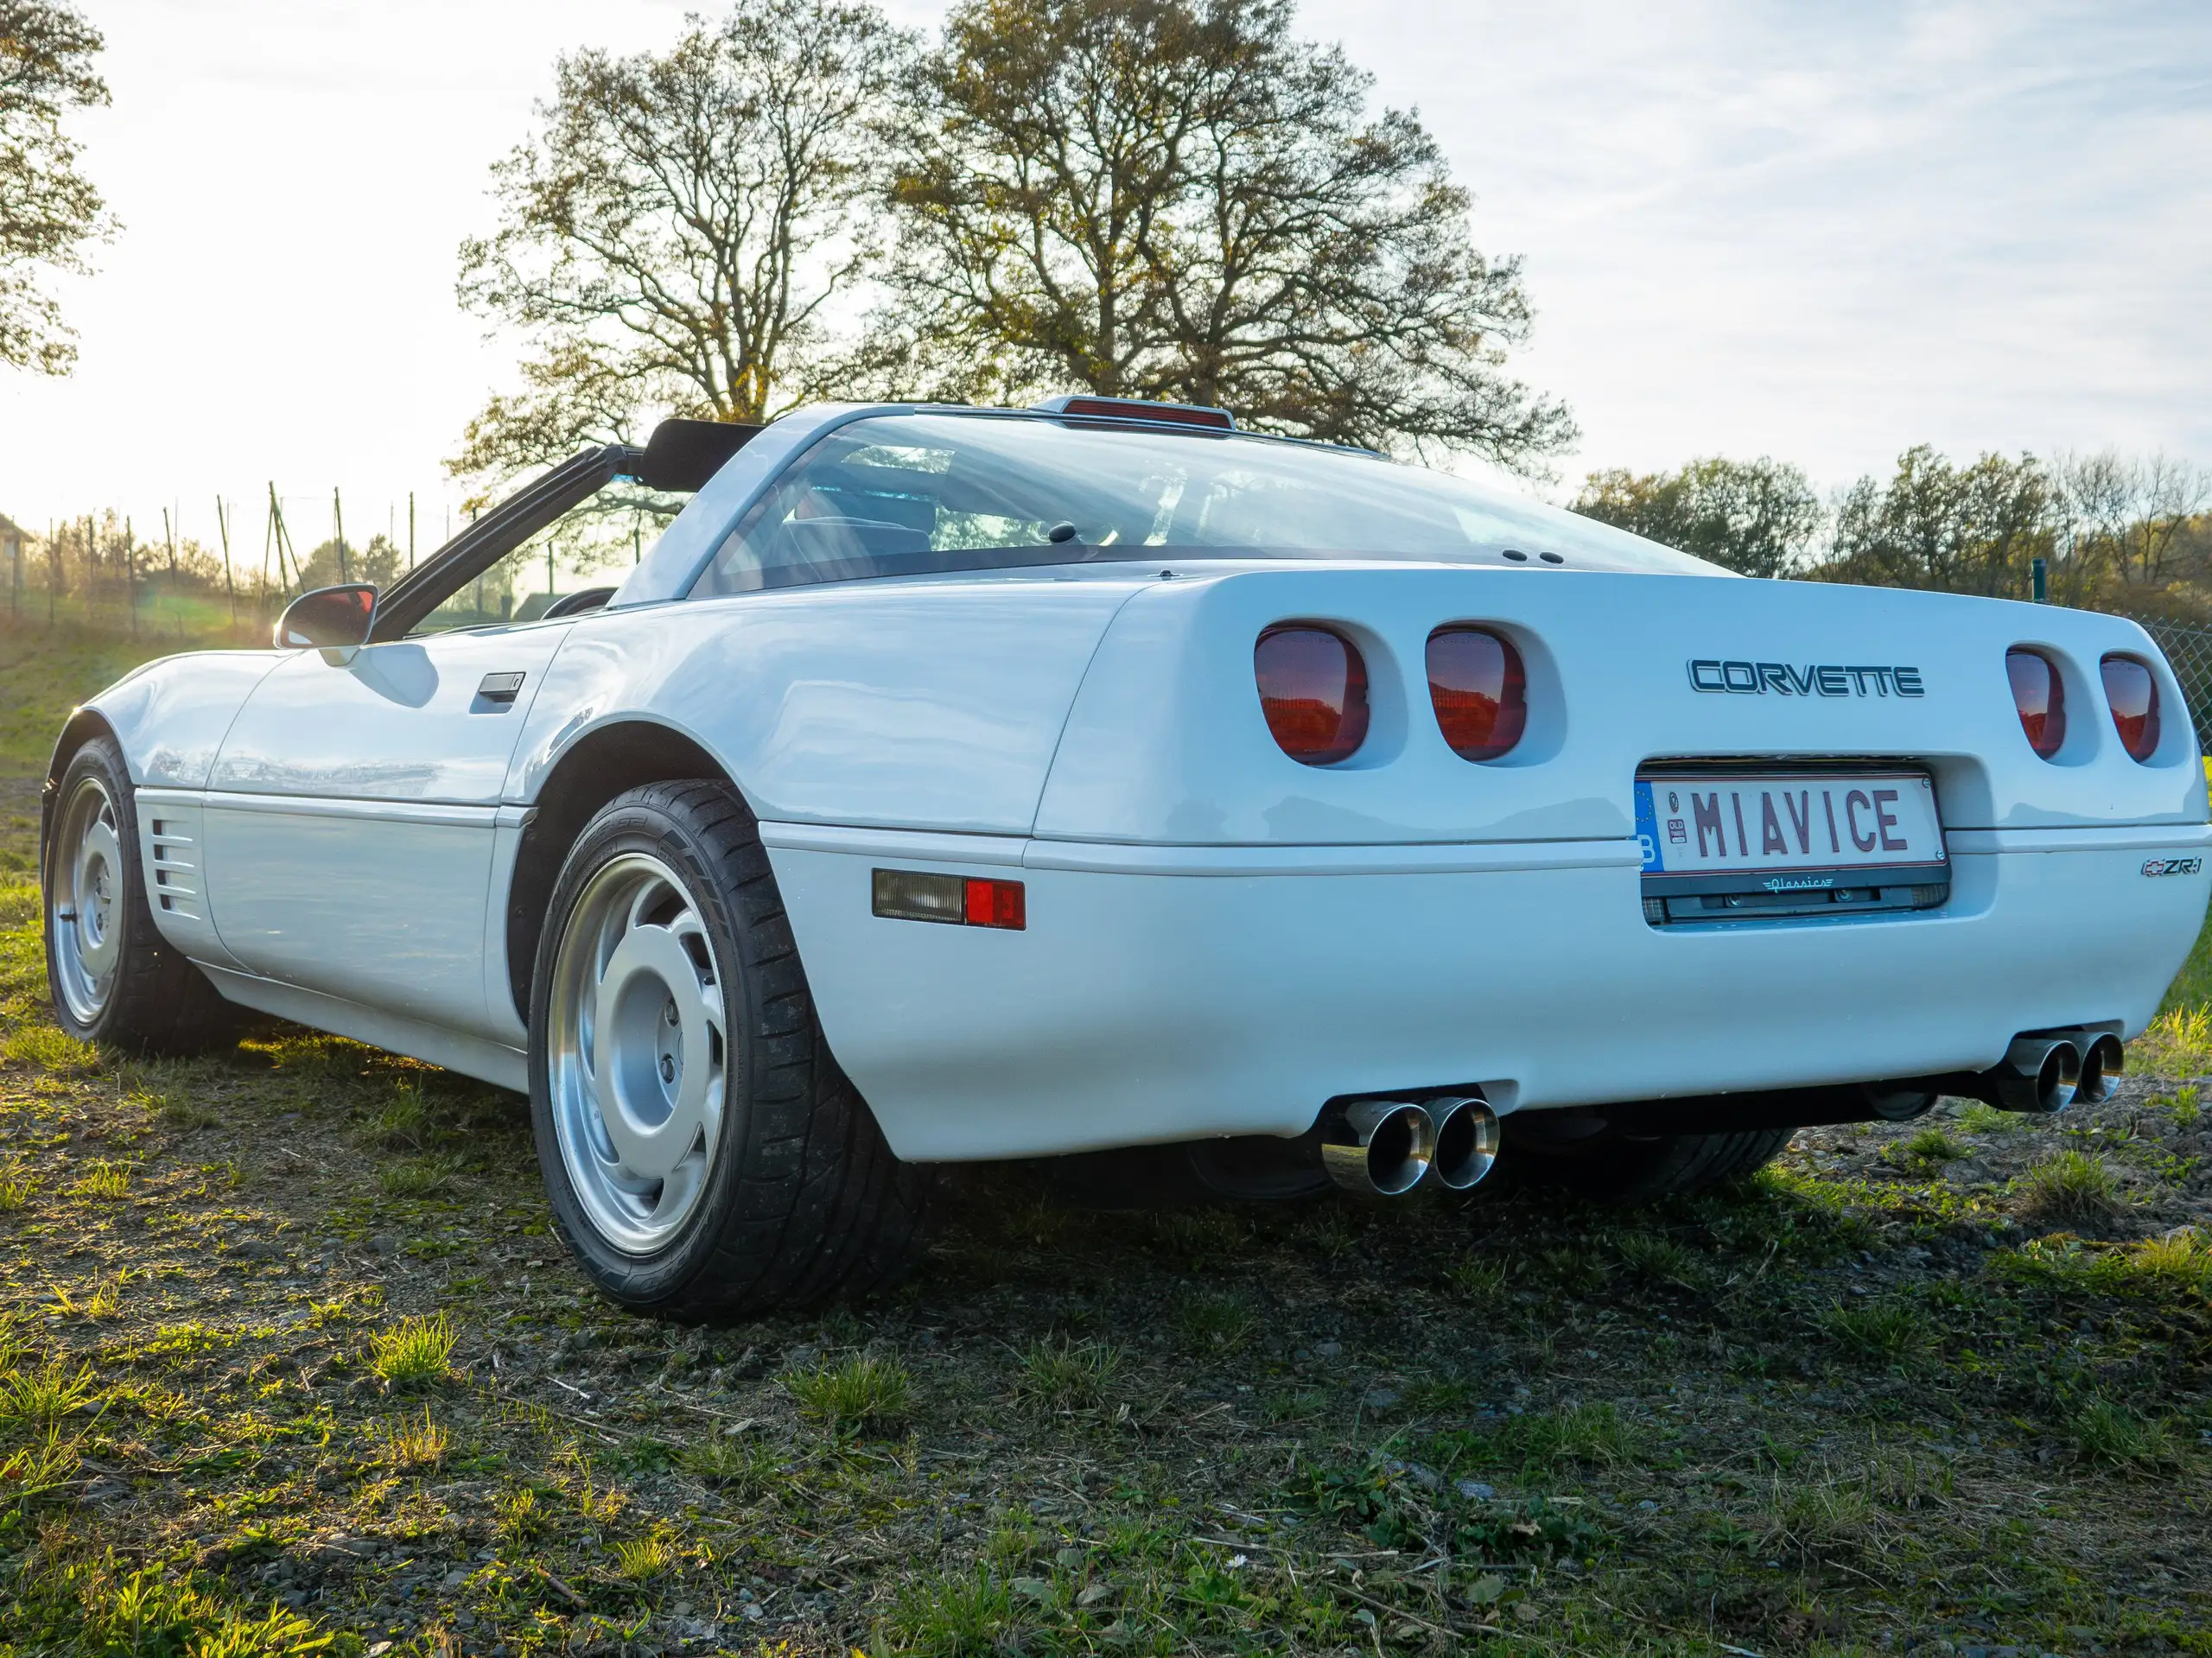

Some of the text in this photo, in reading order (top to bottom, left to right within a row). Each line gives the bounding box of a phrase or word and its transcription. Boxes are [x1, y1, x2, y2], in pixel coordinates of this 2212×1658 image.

[1687, 659, 1925, 697] CORVETTE
[1669, 821, 1683, 829] OLD
[1691, 790, 1908, 857] MIAVICE
[1637, 834, 1656, 863] B
